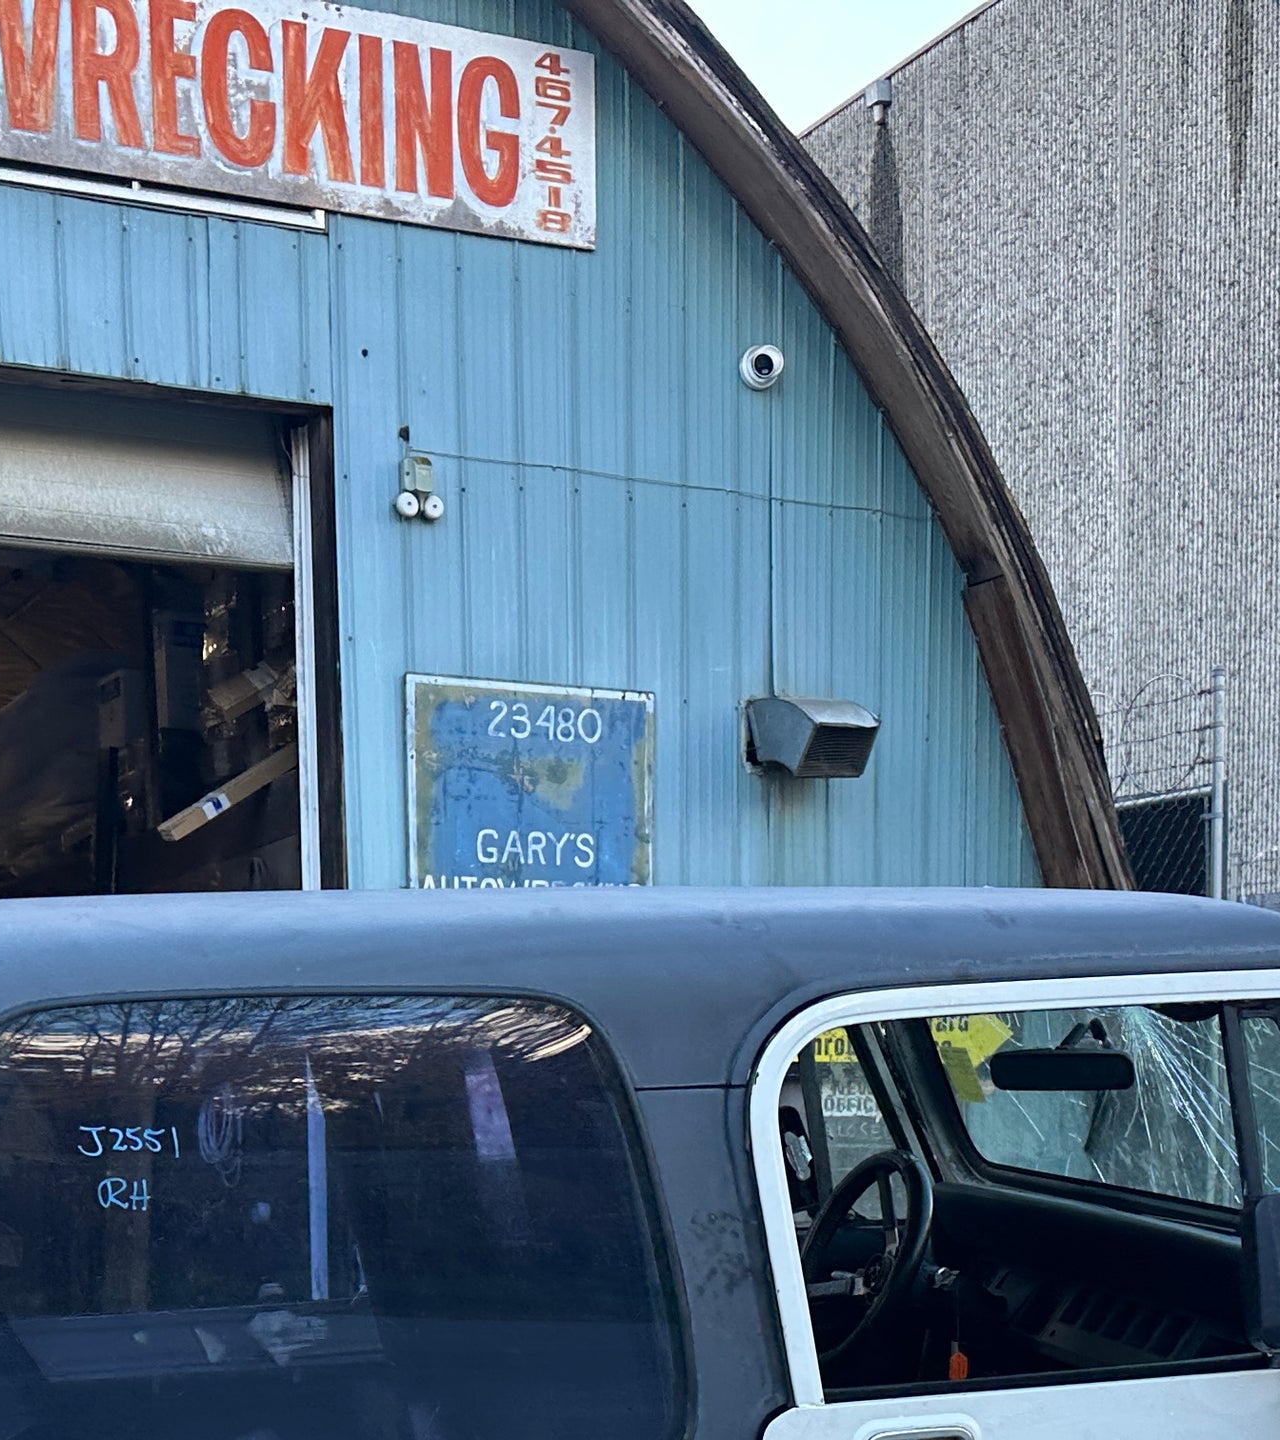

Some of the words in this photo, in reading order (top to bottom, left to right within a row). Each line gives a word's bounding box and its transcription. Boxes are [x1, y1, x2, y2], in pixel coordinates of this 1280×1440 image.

[488, 700, 602, 744] 23480
[476, 828, 595, 868] GARY'S
[77, 1126, 180, 1158] J2551
[97, 1177, 152, 1211] RH
